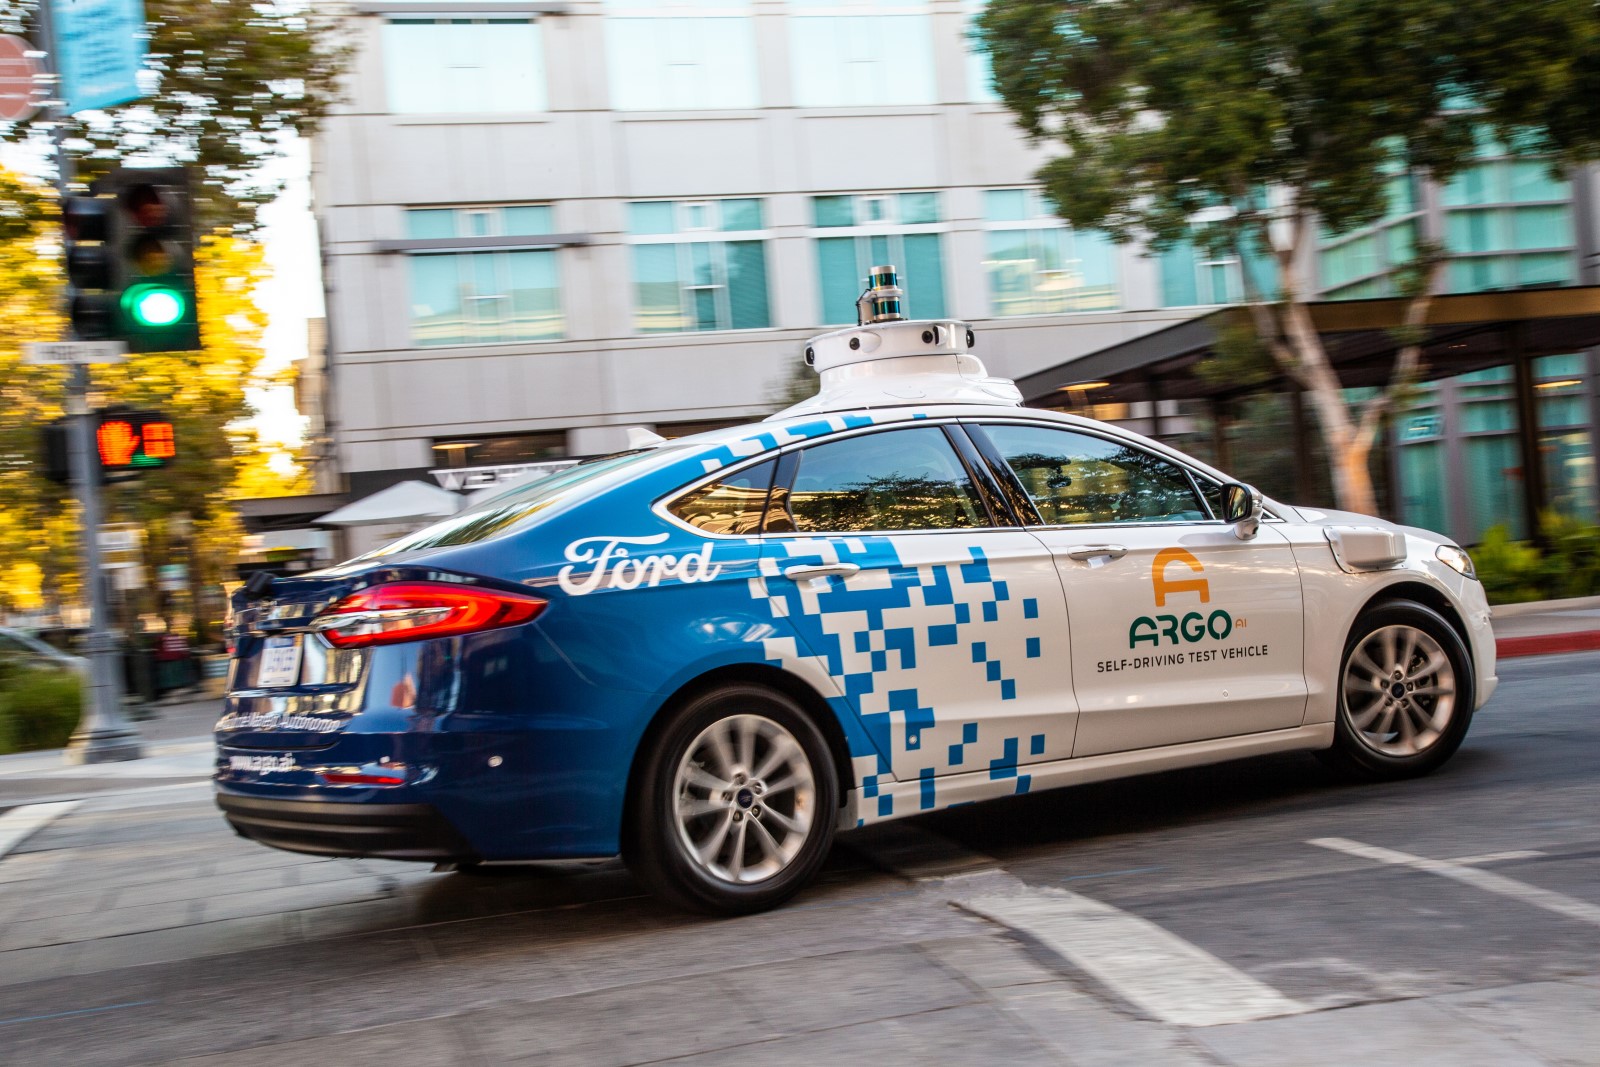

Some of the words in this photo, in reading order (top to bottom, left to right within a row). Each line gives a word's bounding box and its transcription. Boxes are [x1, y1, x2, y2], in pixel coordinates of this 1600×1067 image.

[557, 532, 722, 596] Ford
[1129, 609, 1233, 649] ARGO
[1235, 618, 1247, 629] AI
[1097, 653, 1185, 673] SELF-DRIVING
[1189, 650, 1217, 662] TEST
[1221, 644, 1268, 660] VEHICLE
